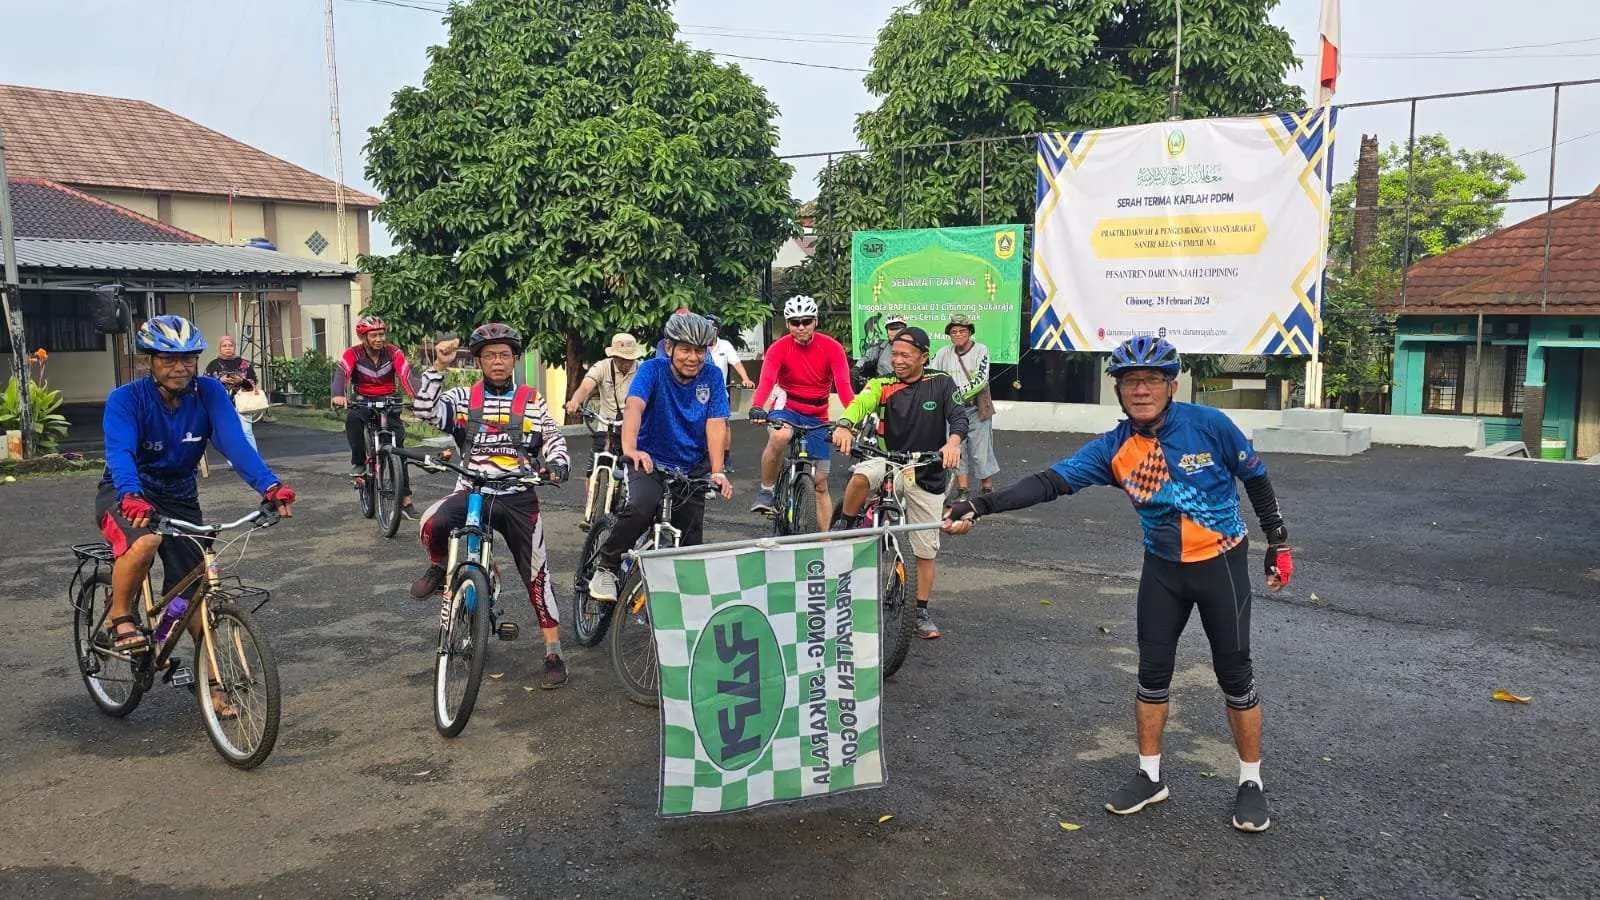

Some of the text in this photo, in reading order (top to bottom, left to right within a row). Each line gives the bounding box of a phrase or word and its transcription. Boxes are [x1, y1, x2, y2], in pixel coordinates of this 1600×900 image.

[1117, 192, 1234, 208] SERAH TERIMA KAFILAH PDPM
[1212, 223, 1256, 234] MASYARAKAT
[1105, 267, 1239, 279] PESANTREN DARUNNAJAH 2 CIPINING
[892, 276, 977, 287] SELAMAT DATANG
[1157, 296, 1165, 306] 28
[1166, 296, 1193, 305] Februari
[1194, 295, 1210, 305] 2024
[858, 303, 887, 312] Anggota
[888, 303, 907, 311] RAPI
[909, 303, 928, 311] Lokal
[941, 303, 976, 312] Cibinong
[978, 302, 1014, 313] Sukaraja
